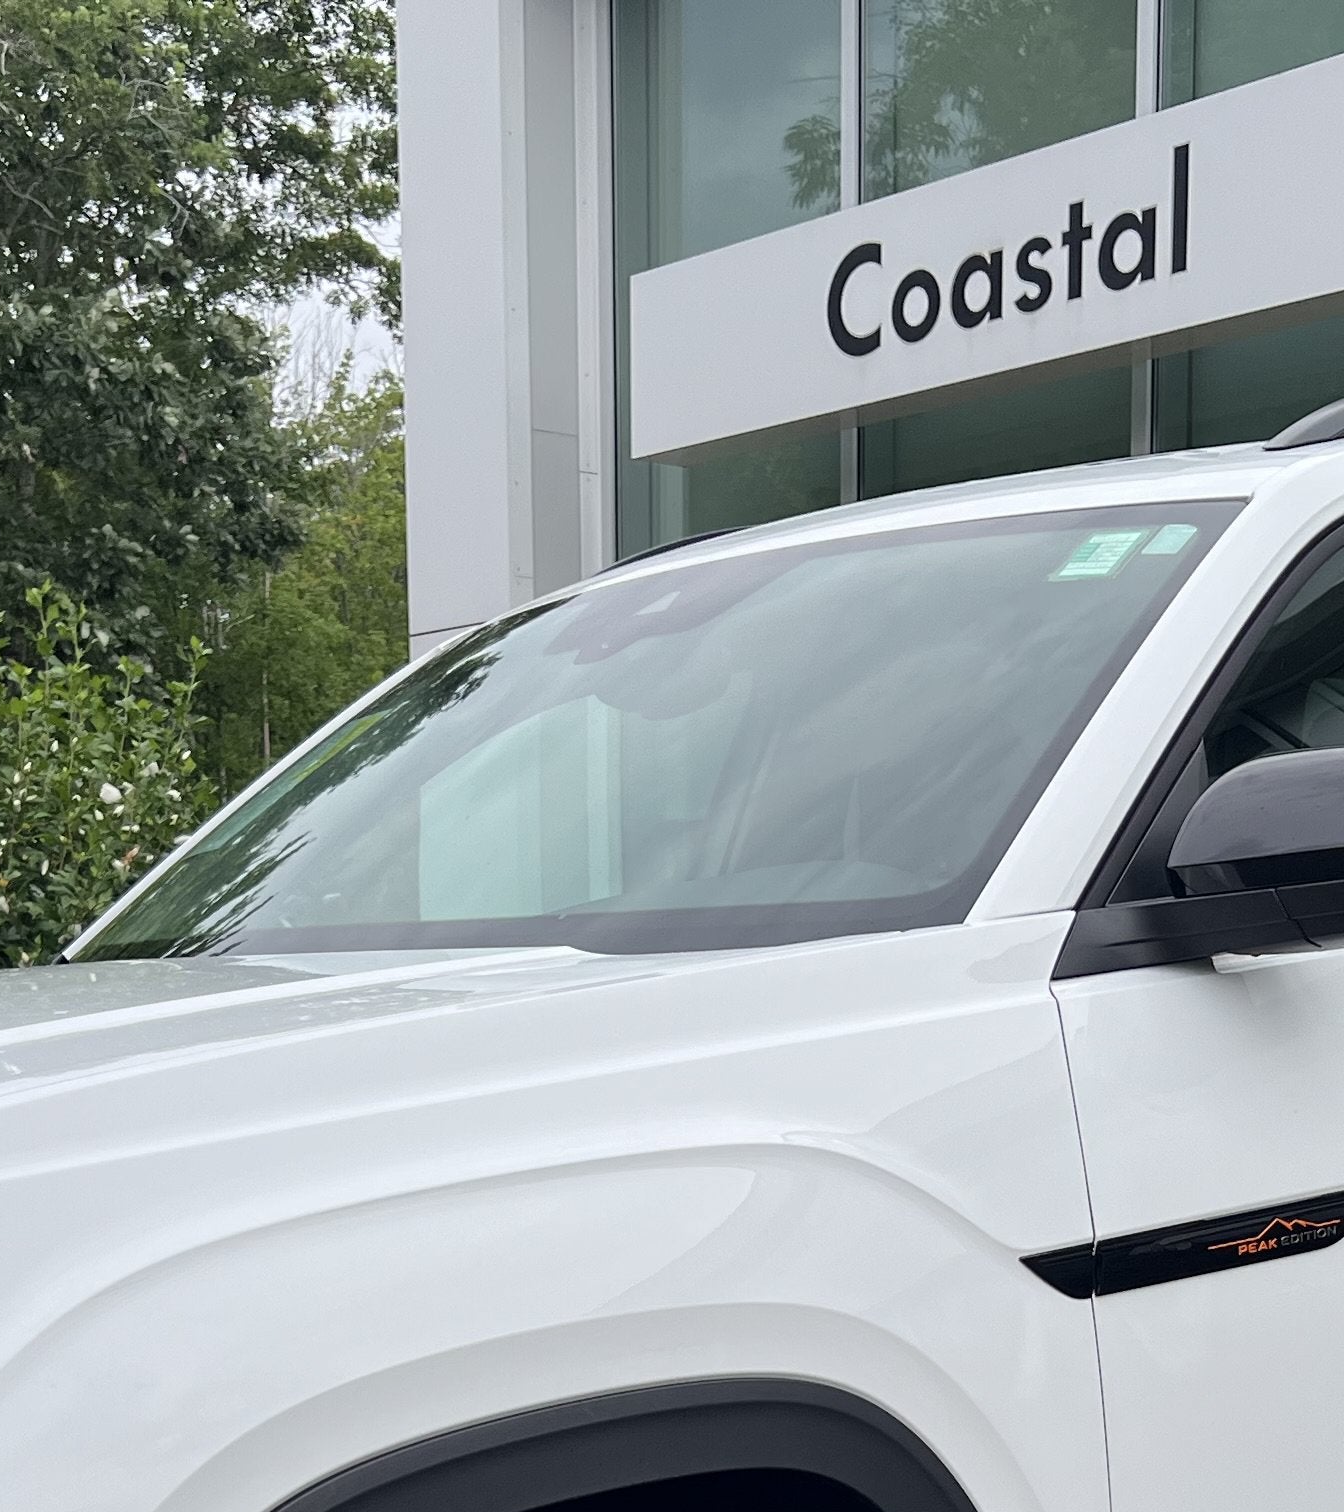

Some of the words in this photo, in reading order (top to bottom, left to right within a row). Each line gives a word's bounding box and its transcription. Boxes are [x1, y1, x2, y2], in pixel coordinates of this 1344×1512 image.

[827, 143, 1189, 357] Coastal
[1238, 1239, 1278, 1256] PEAK
[1280, 1225, 1337, 1247] EDITION
